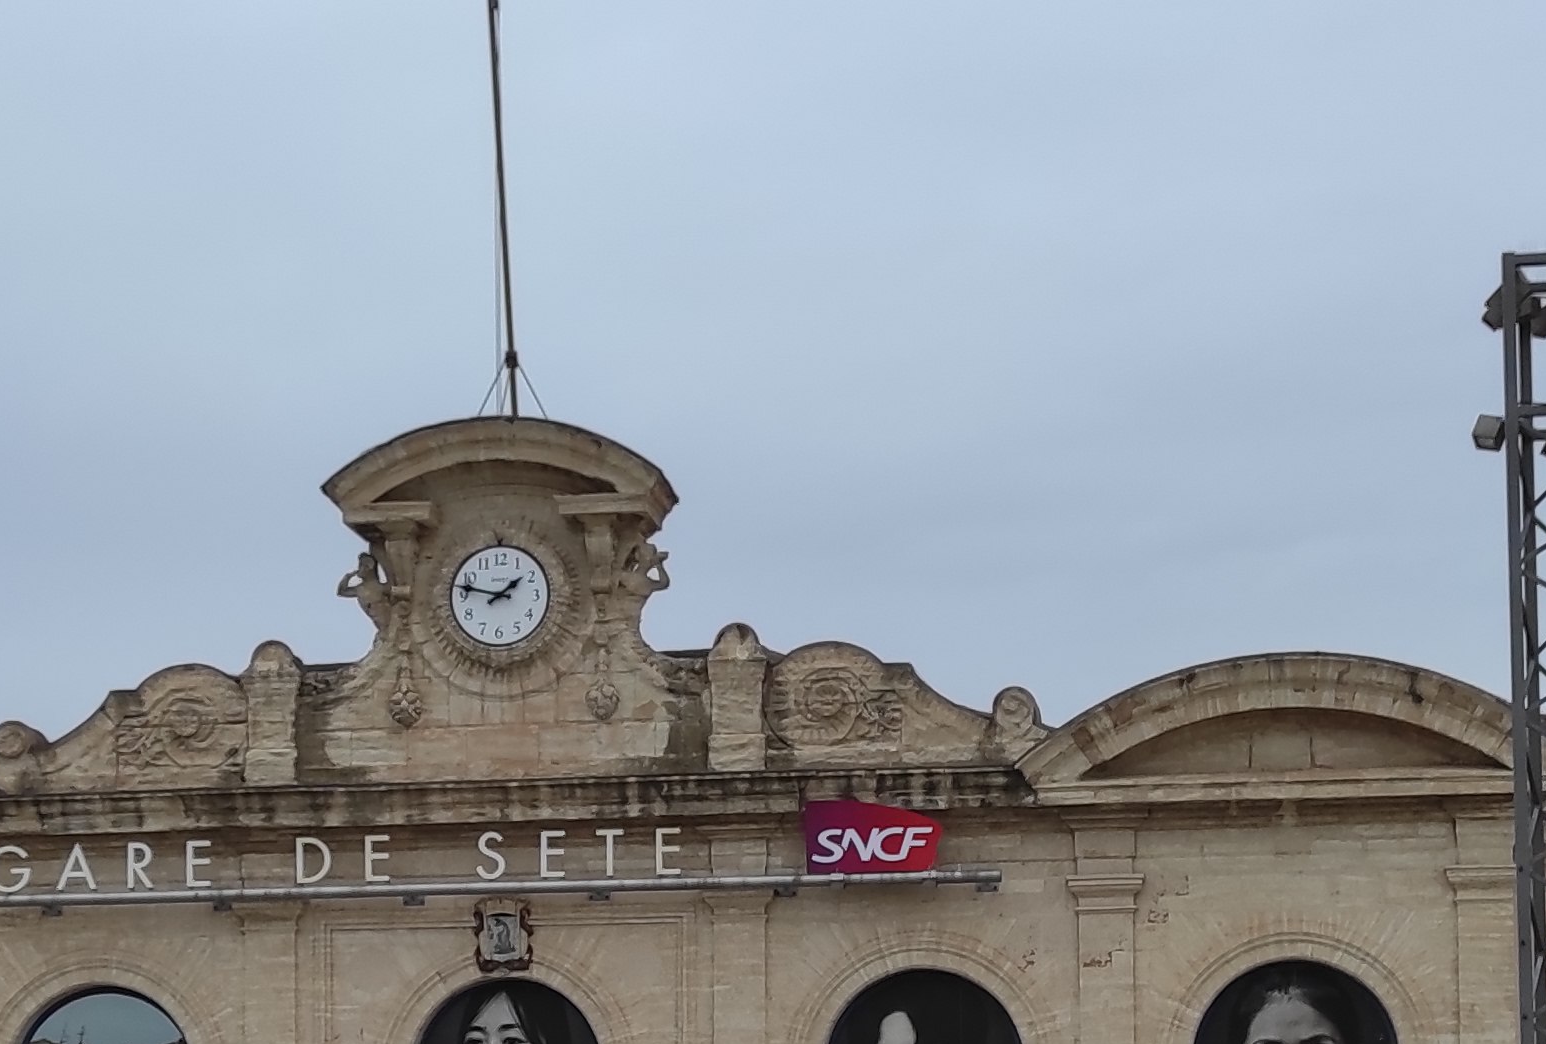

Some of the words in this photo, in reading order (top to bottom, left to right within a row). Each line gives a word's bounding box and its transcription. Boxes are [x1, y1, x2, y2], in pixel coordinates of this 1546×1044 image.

[478, 557, 490, 570] 11
[493, 552, 508, 567] 12
[515, 557, 520, 570] 1
[463, 571, 477, 585] 10
[527, 570, 536, 583] 2
[459, 588, 469, 602] 9
[533, 588, 541, 601] 3
[464, 607, 473, 621] 8
[524, 607, 533, 621] 4
[478, 622, 487, 636] 7
[494, 625, 504, 640] 6
[513, 621, 521, 635] 5
[810, 826, 934, 864] SNCF
[294, 835, 391, 886] DE
[475, 827, 683, 881] SETE
